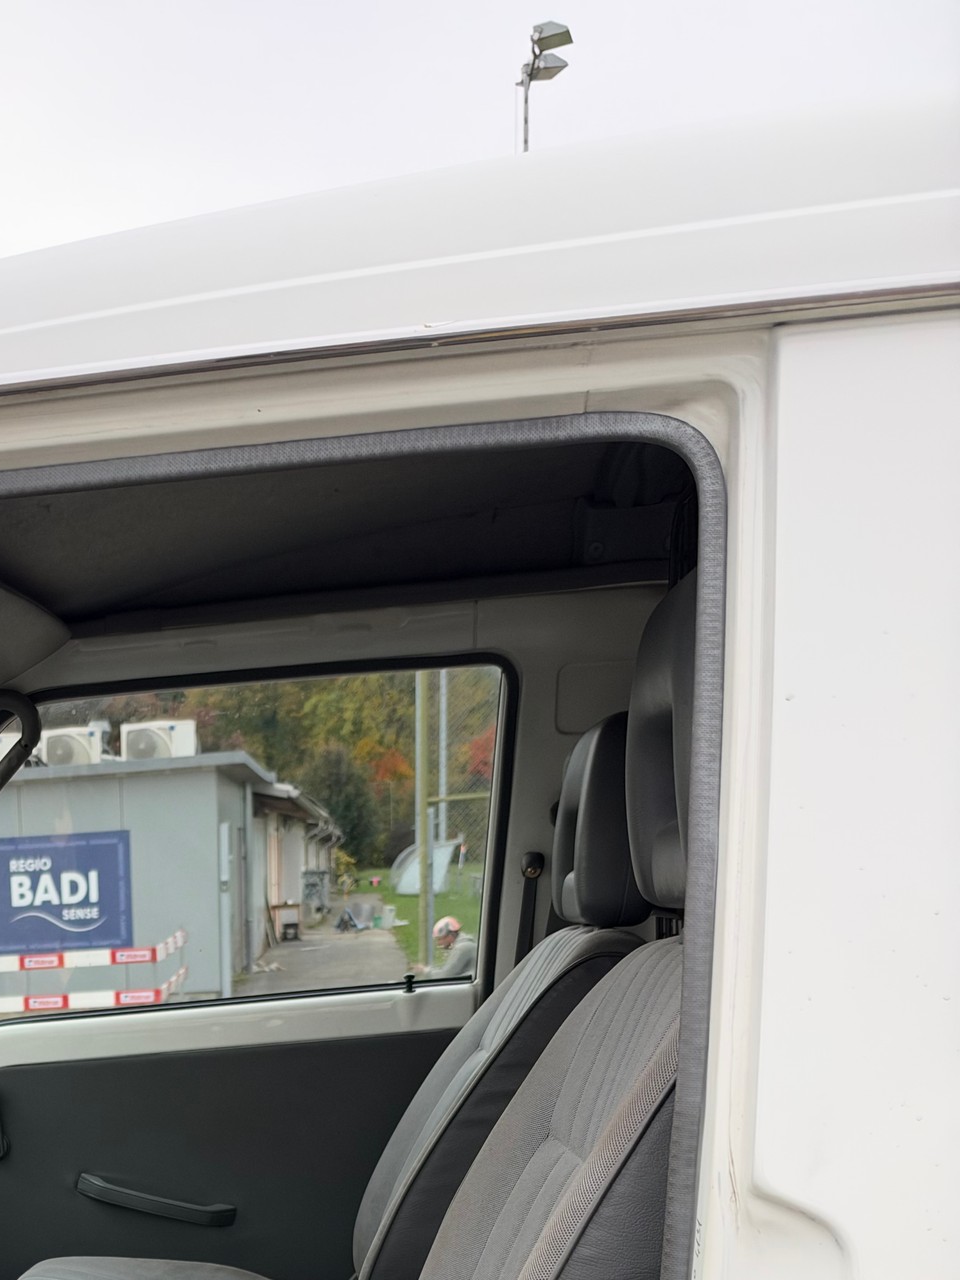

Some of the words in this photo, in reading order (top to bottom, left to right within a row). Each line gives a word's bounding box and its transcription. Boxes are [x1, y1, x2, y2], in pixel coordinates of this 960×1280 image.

[9, 858, 52, 872] REGIO
[10, 870, 100, 908] BADI
[62, 907, 100, 921] SENSE
